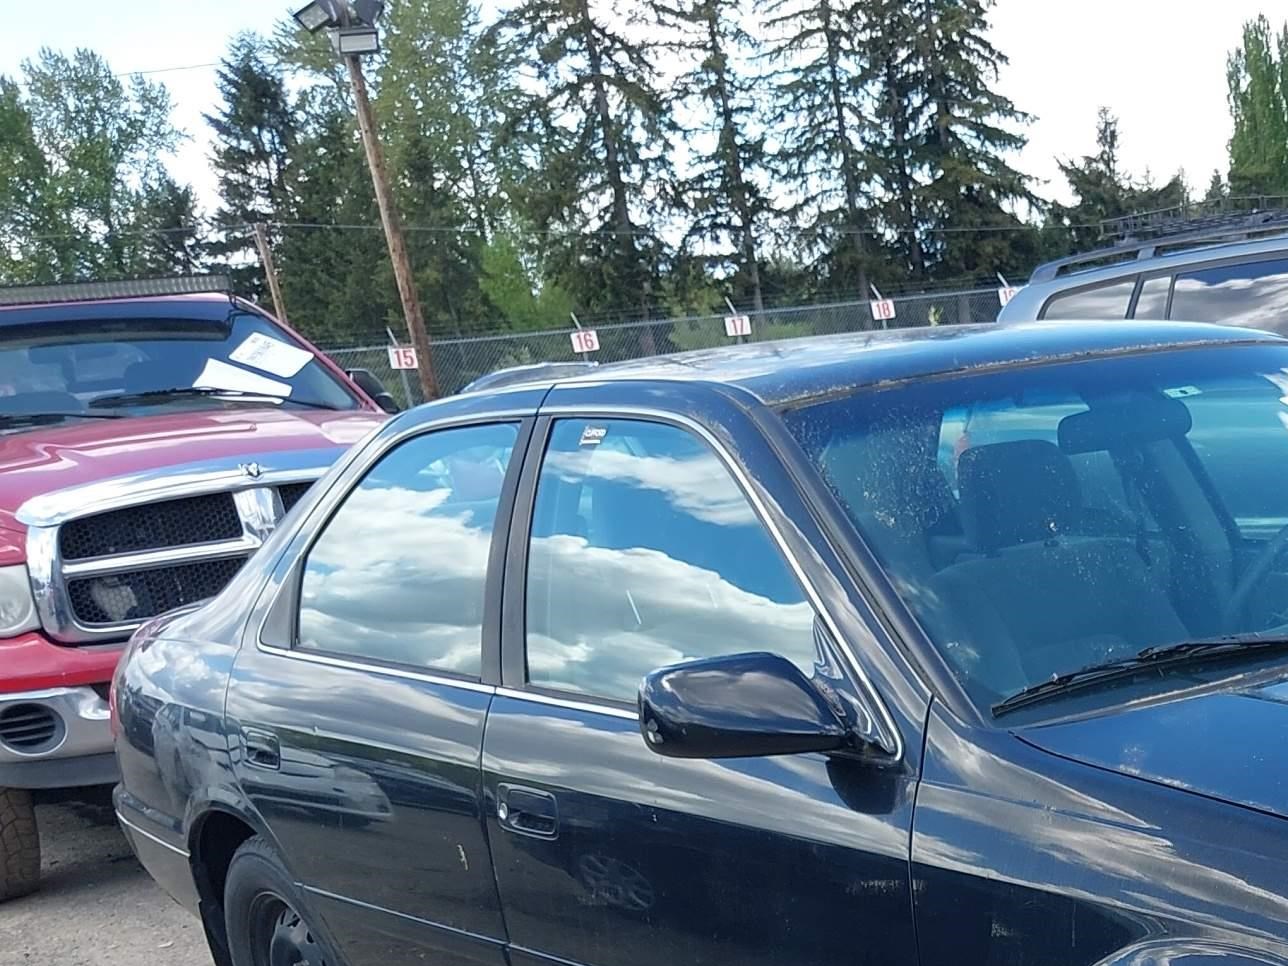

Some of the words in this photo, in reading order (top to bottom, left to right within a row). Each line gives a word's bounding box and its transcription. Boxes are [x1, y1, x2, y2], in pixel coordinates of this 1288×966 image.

[876, 302, 890, 318] 18
[732, 318, 744, 334] 17
[576, 333, 594, 350] 16
[394, 350, 414, 367] 15
